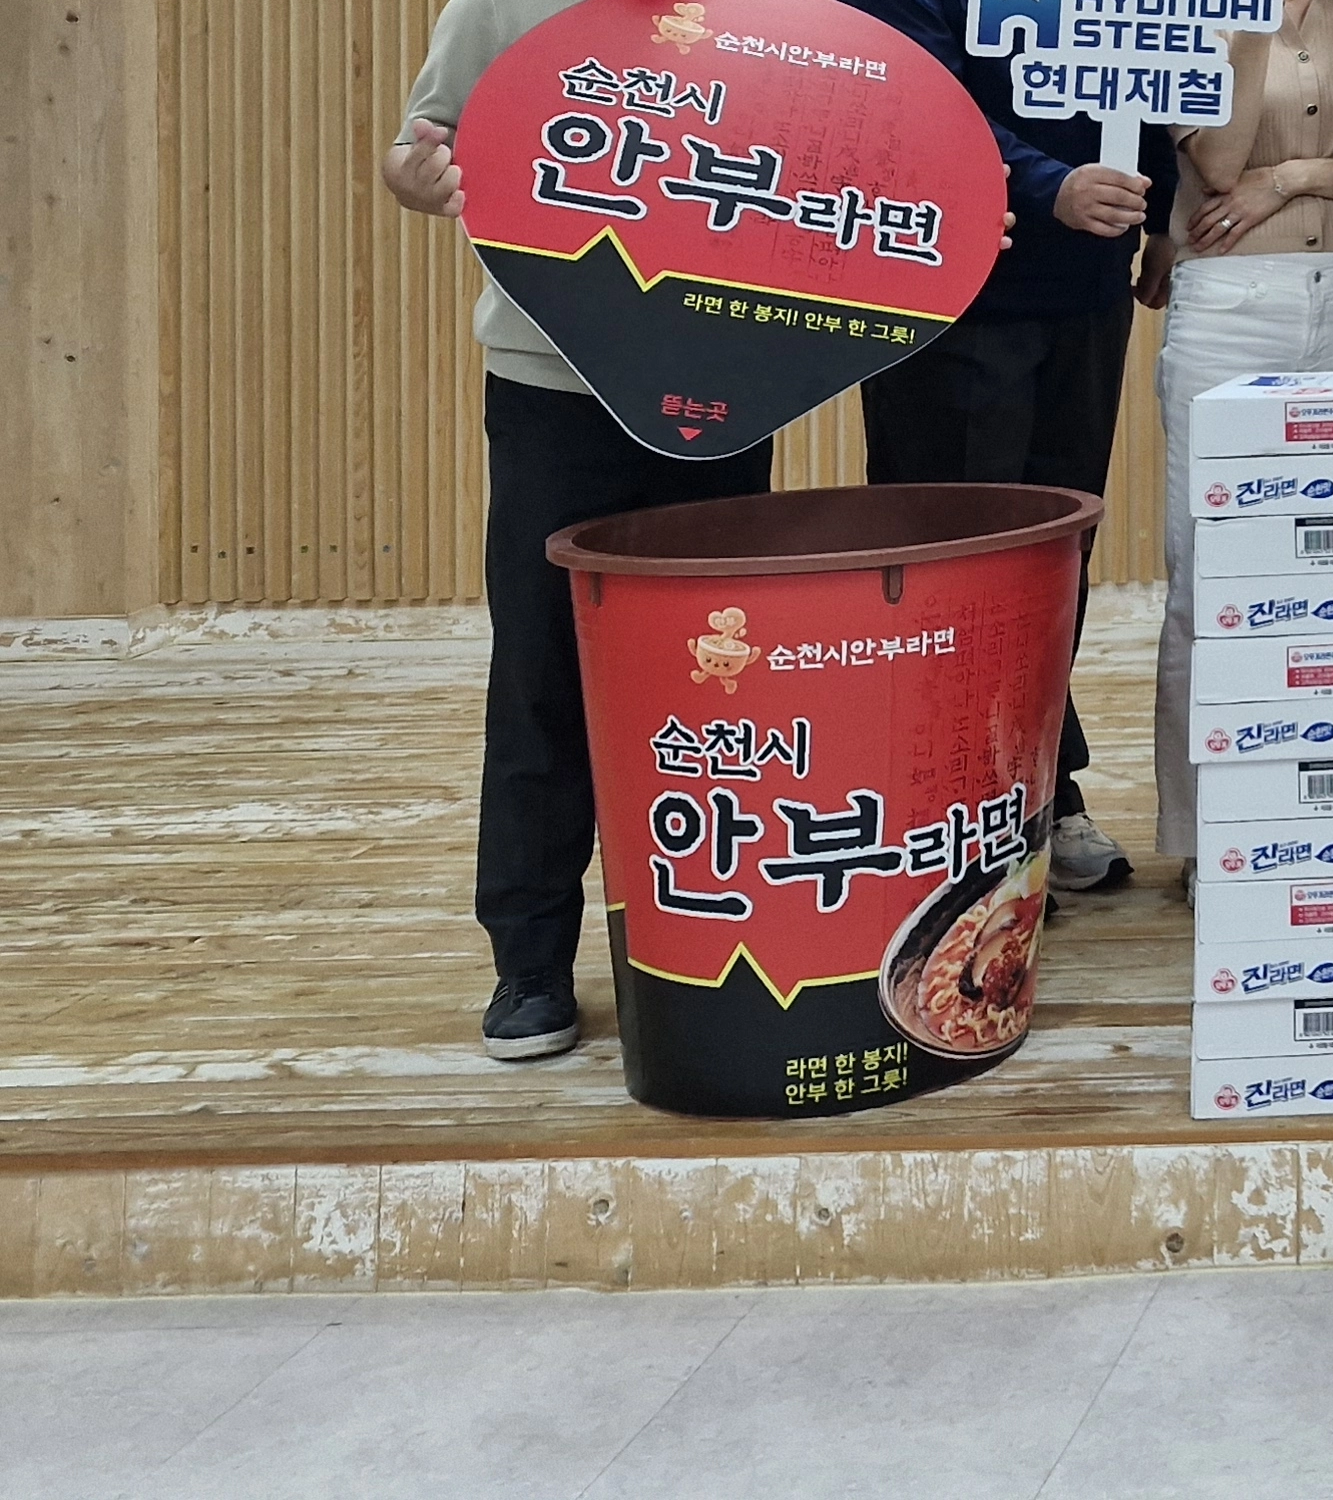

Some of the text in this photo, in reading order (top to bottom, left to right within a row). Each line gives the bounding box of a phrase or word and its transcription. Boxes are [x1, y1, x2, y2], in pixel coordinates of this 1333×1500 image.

[713, 30, 888, 81] 순천시안부라면
[1073, 18, 1216, 54] STEEL
[559, 57, 727, 123] 순천시
[1022, 61, 1222, 116] 현대제철
[532, 111, 943, 267] 안부라면
[683, 293, 916, 345] 라면 한 봉지! 안부 한 그릇!
[1235, 477, 1298, 507] 진라면
[1247, 599, 1308, 629] 진라면
[766, 626, 956, 671] 순천시안부라면
[650, 716, 812, 780] 순천시
[1235, 721, 1298, 753] 진라면
[648, 784, 1027, 922] 안부라면
[1250, 842, 1312, 873] 진라면
[1241, 962, 1304, 994] 진라면
[786, 1041, 908, 1080] 라면 한 봉지!
[785, 1066, 908, 1105] 안부 한 그릇!
[1245, 1081, 1306, 1110] 진라면
